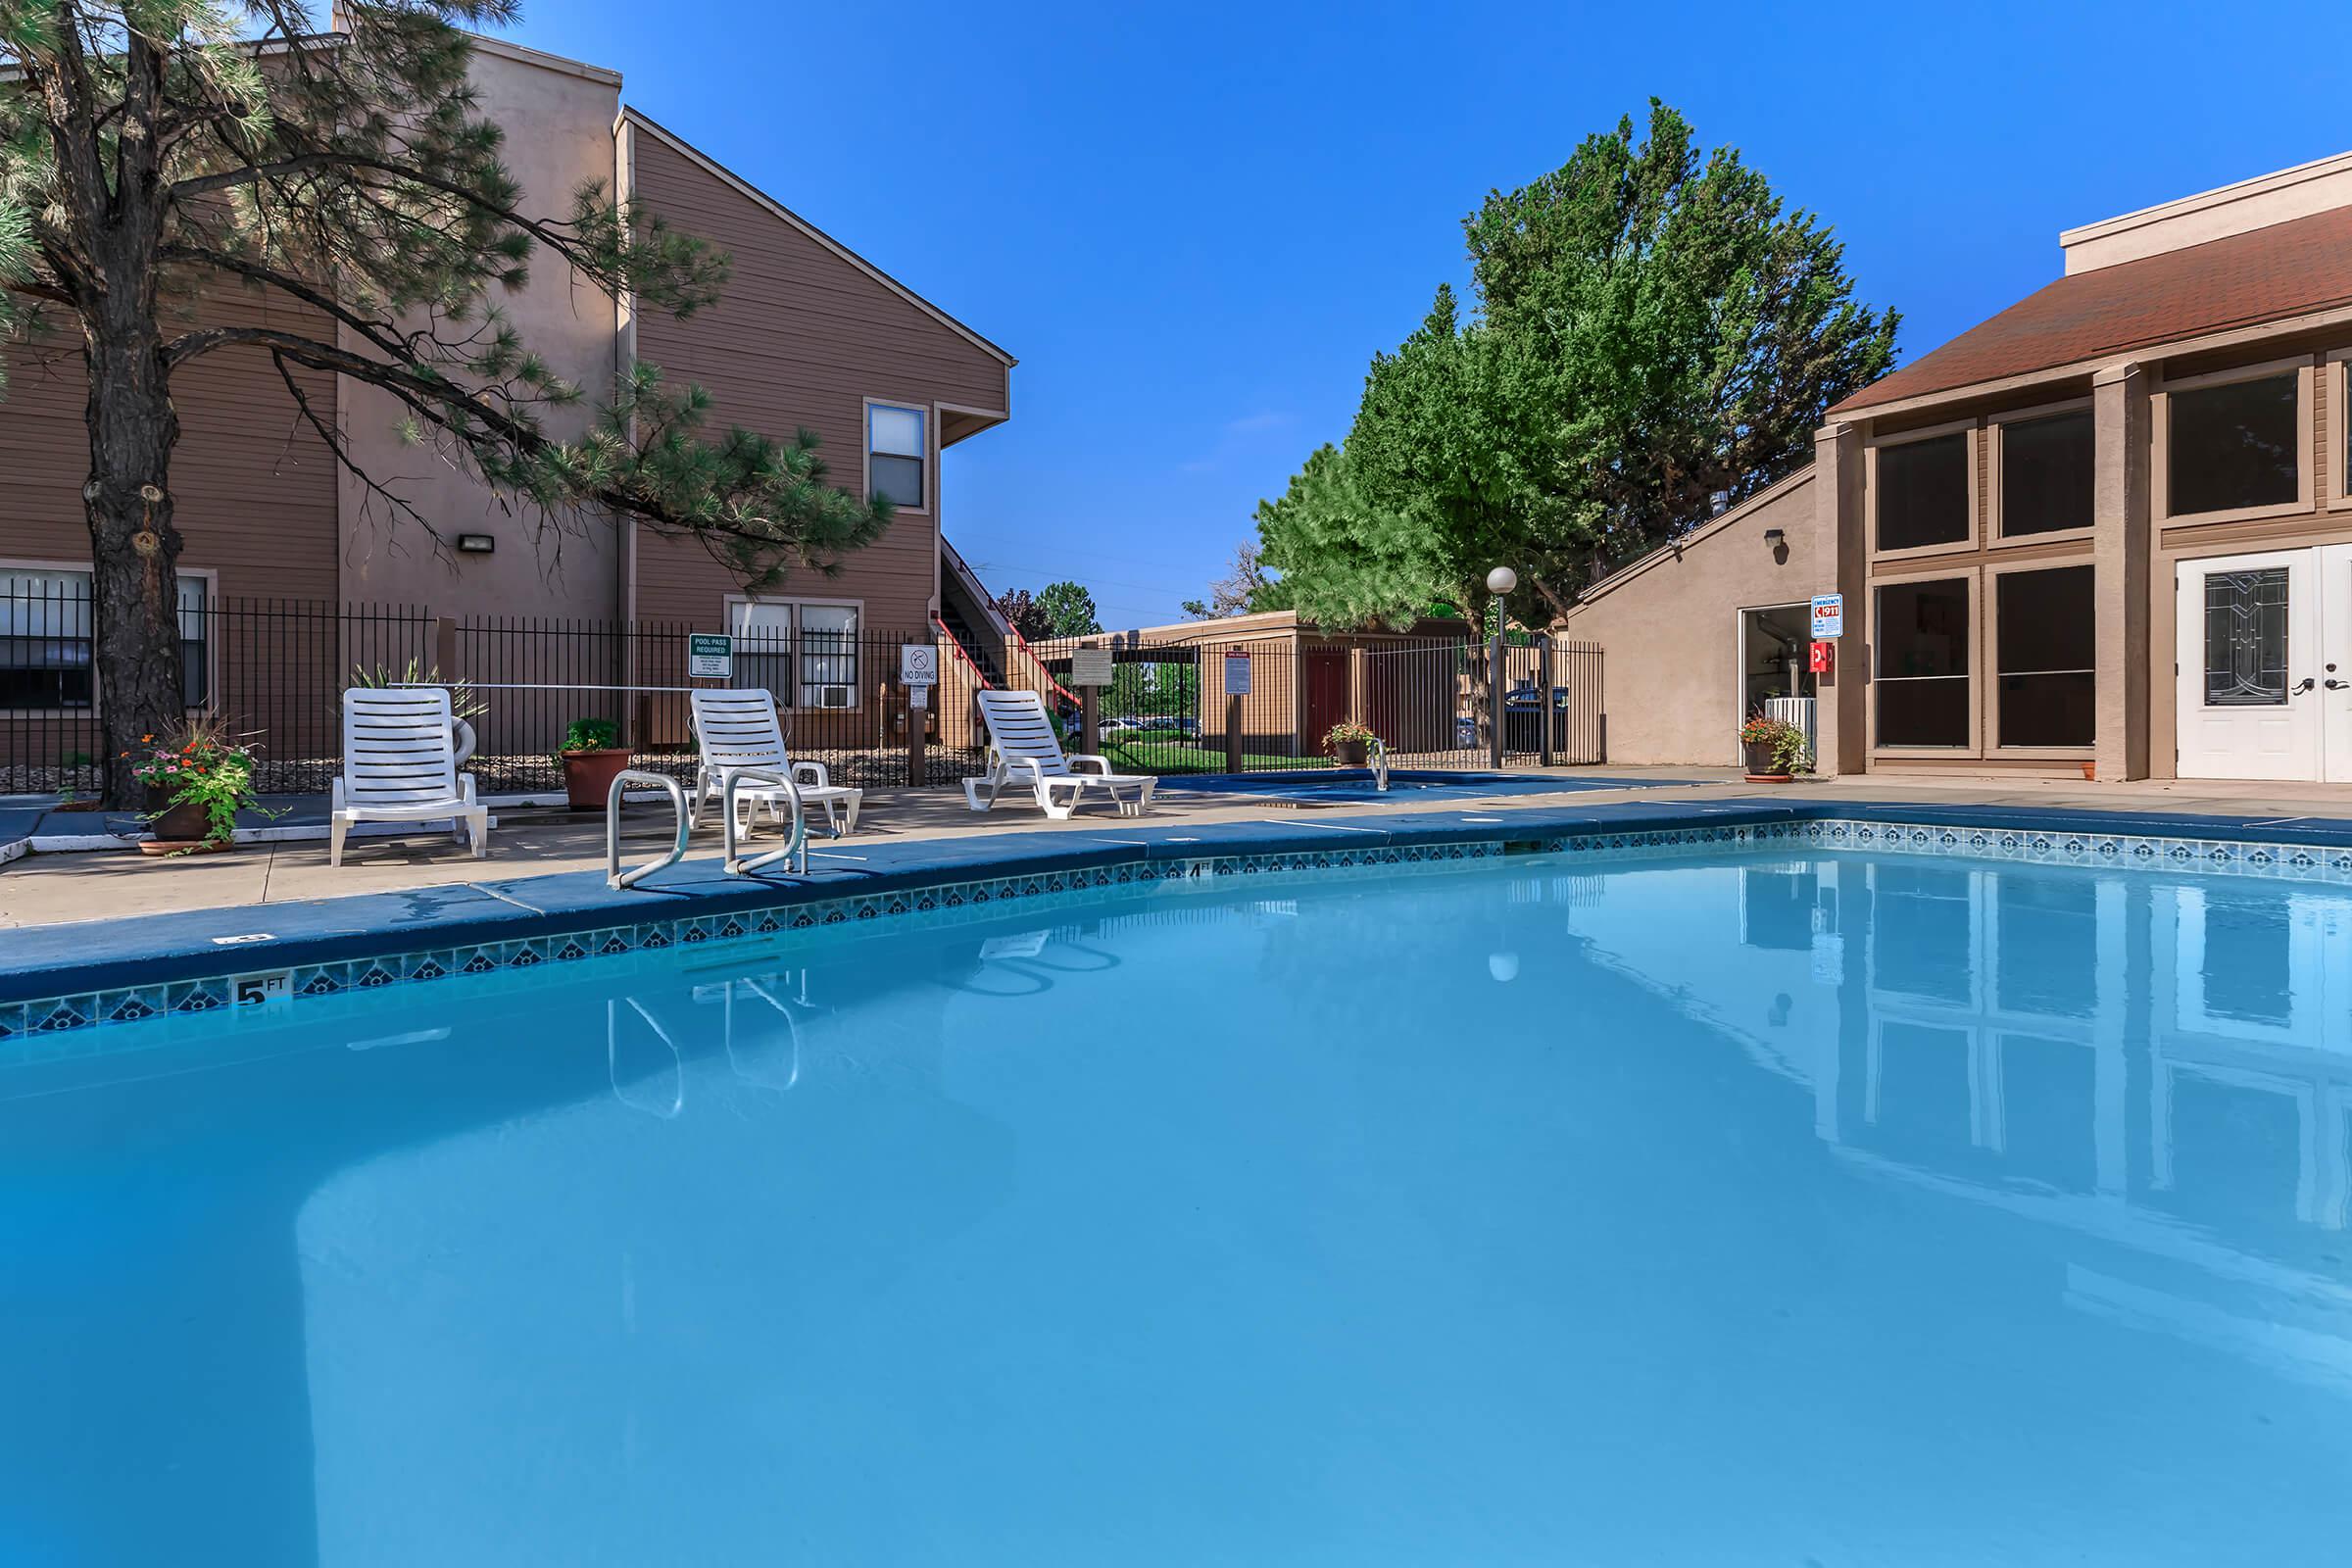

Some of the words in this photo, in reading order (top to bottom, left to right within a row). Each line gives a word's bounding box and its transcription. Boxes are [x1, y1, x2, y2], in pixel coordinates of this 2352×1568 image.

[1824, 607, 1838, 616] 911
[905, 670, 913, 680] NO
[914, 670, 935, 680] DIVING
[237, 980, 266, 1005] 5
[268, 977, 286, 992] FT
